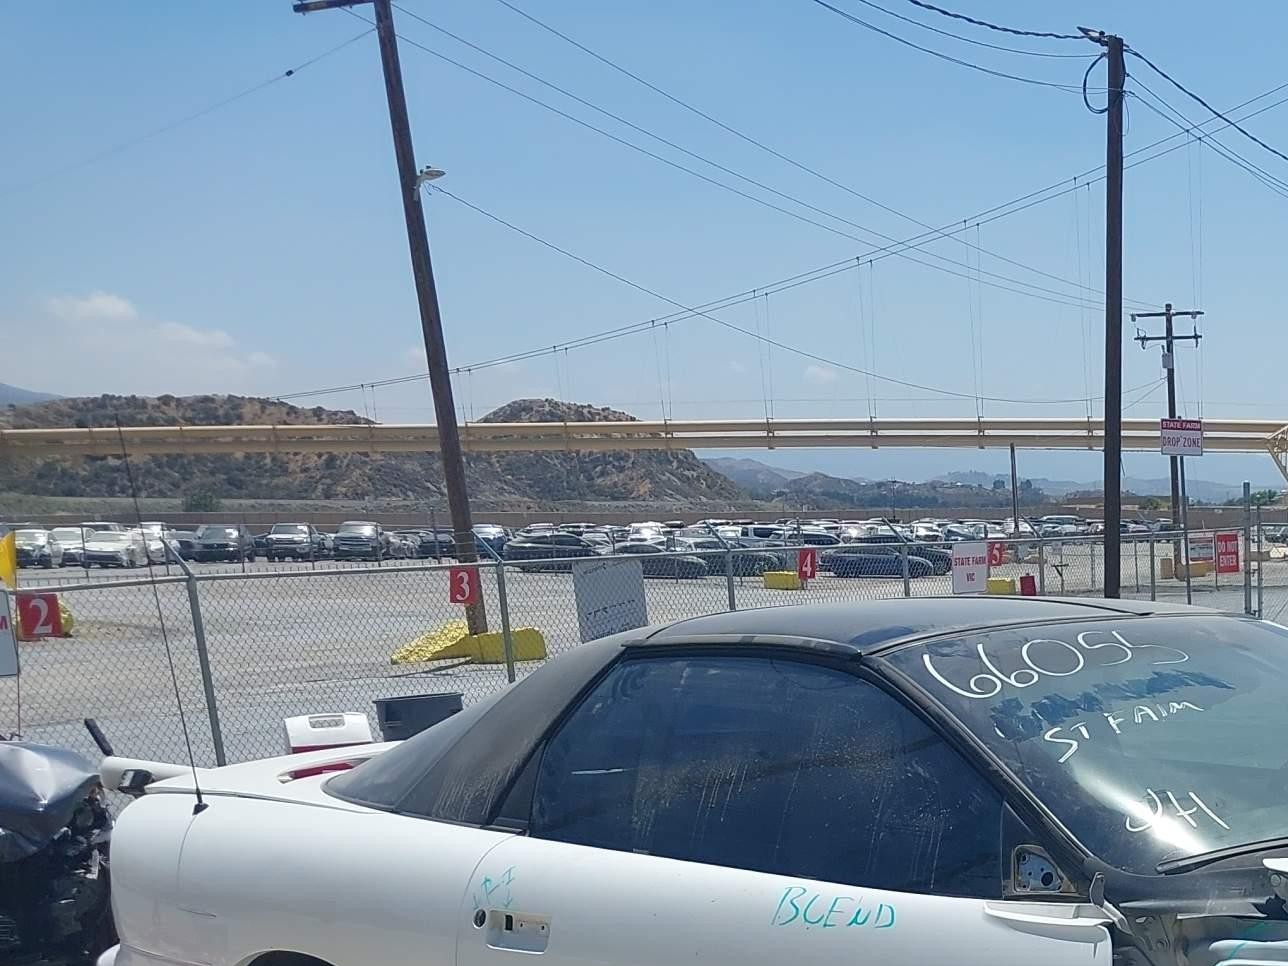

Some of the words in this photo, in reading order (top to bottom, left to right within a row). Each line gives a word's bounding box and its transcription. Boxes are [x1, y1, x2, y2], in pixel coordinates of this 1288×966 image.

[1162, 421, 1181, 429] STATE
[1182, 421, 1200, 430] FARM
[1162, 436, 1180, 447] DROP
[1182, 437, 1201, 448] ZONE
[1217, 541, 1226, 553] DO
[1226, 540, 1238, 553] NOT
[991, 543, 1001, 564] 5
[801, 552, 812, 577] 4
[954, 556, 971, 567] STATE
[972, 555, 987, 566] FARM
[1219, 554, 1237, 567] ENTER
[455, 571, 471, 601] 3
[29, 598, 53, 634] 2
